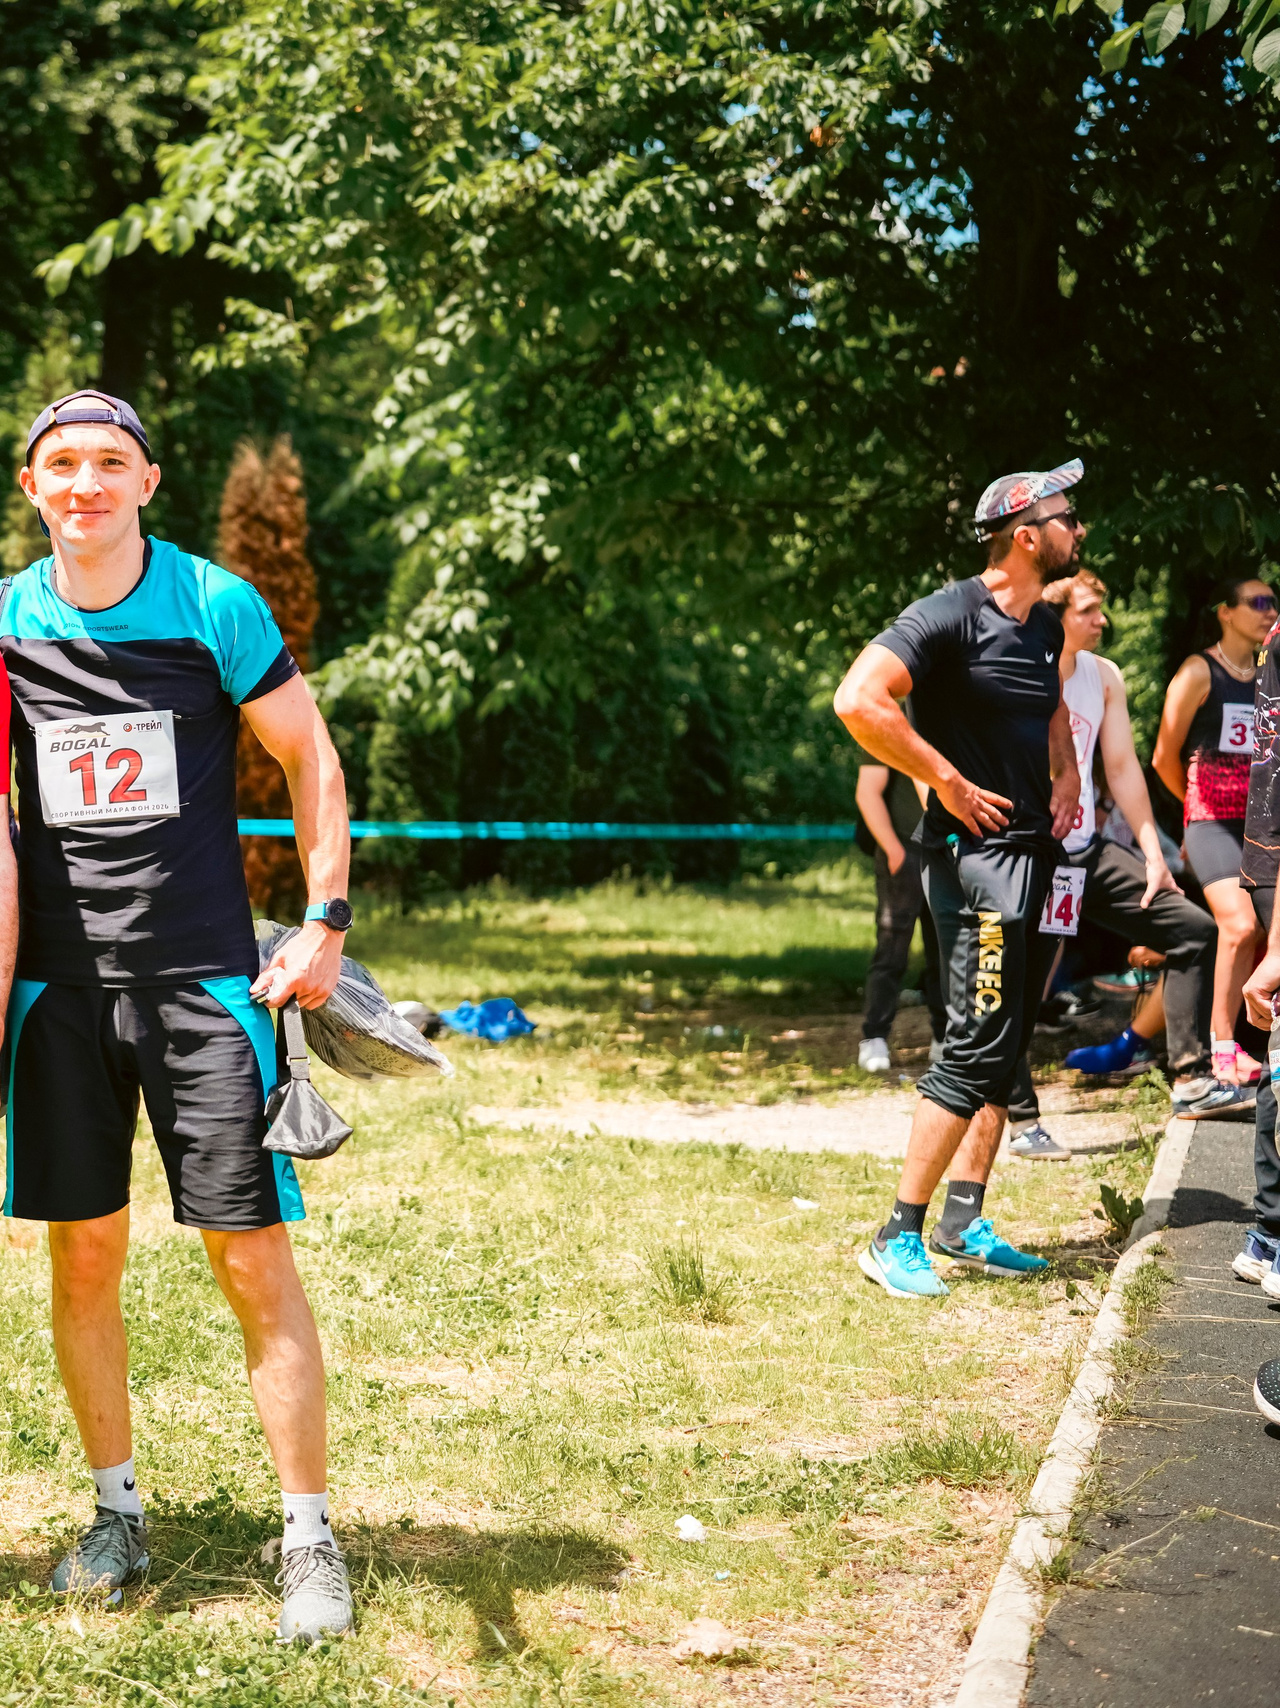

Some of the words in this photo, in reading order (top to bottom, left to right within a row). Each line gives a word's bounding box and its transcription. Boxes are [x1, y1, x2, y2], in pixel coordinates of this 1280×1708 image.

[1229, 722, 1254, 746] 3
[49, 737, 111, 753] BOGAL
[69, 747, 147, 806] 12
[50, 808, 104, 819] СПОРТИВНЫЙ
[105, 805, 150, 814] МАРАФОН
[1053, 883, 1073, 891] GAL
[978, 911, 1004, 971] NIKE
